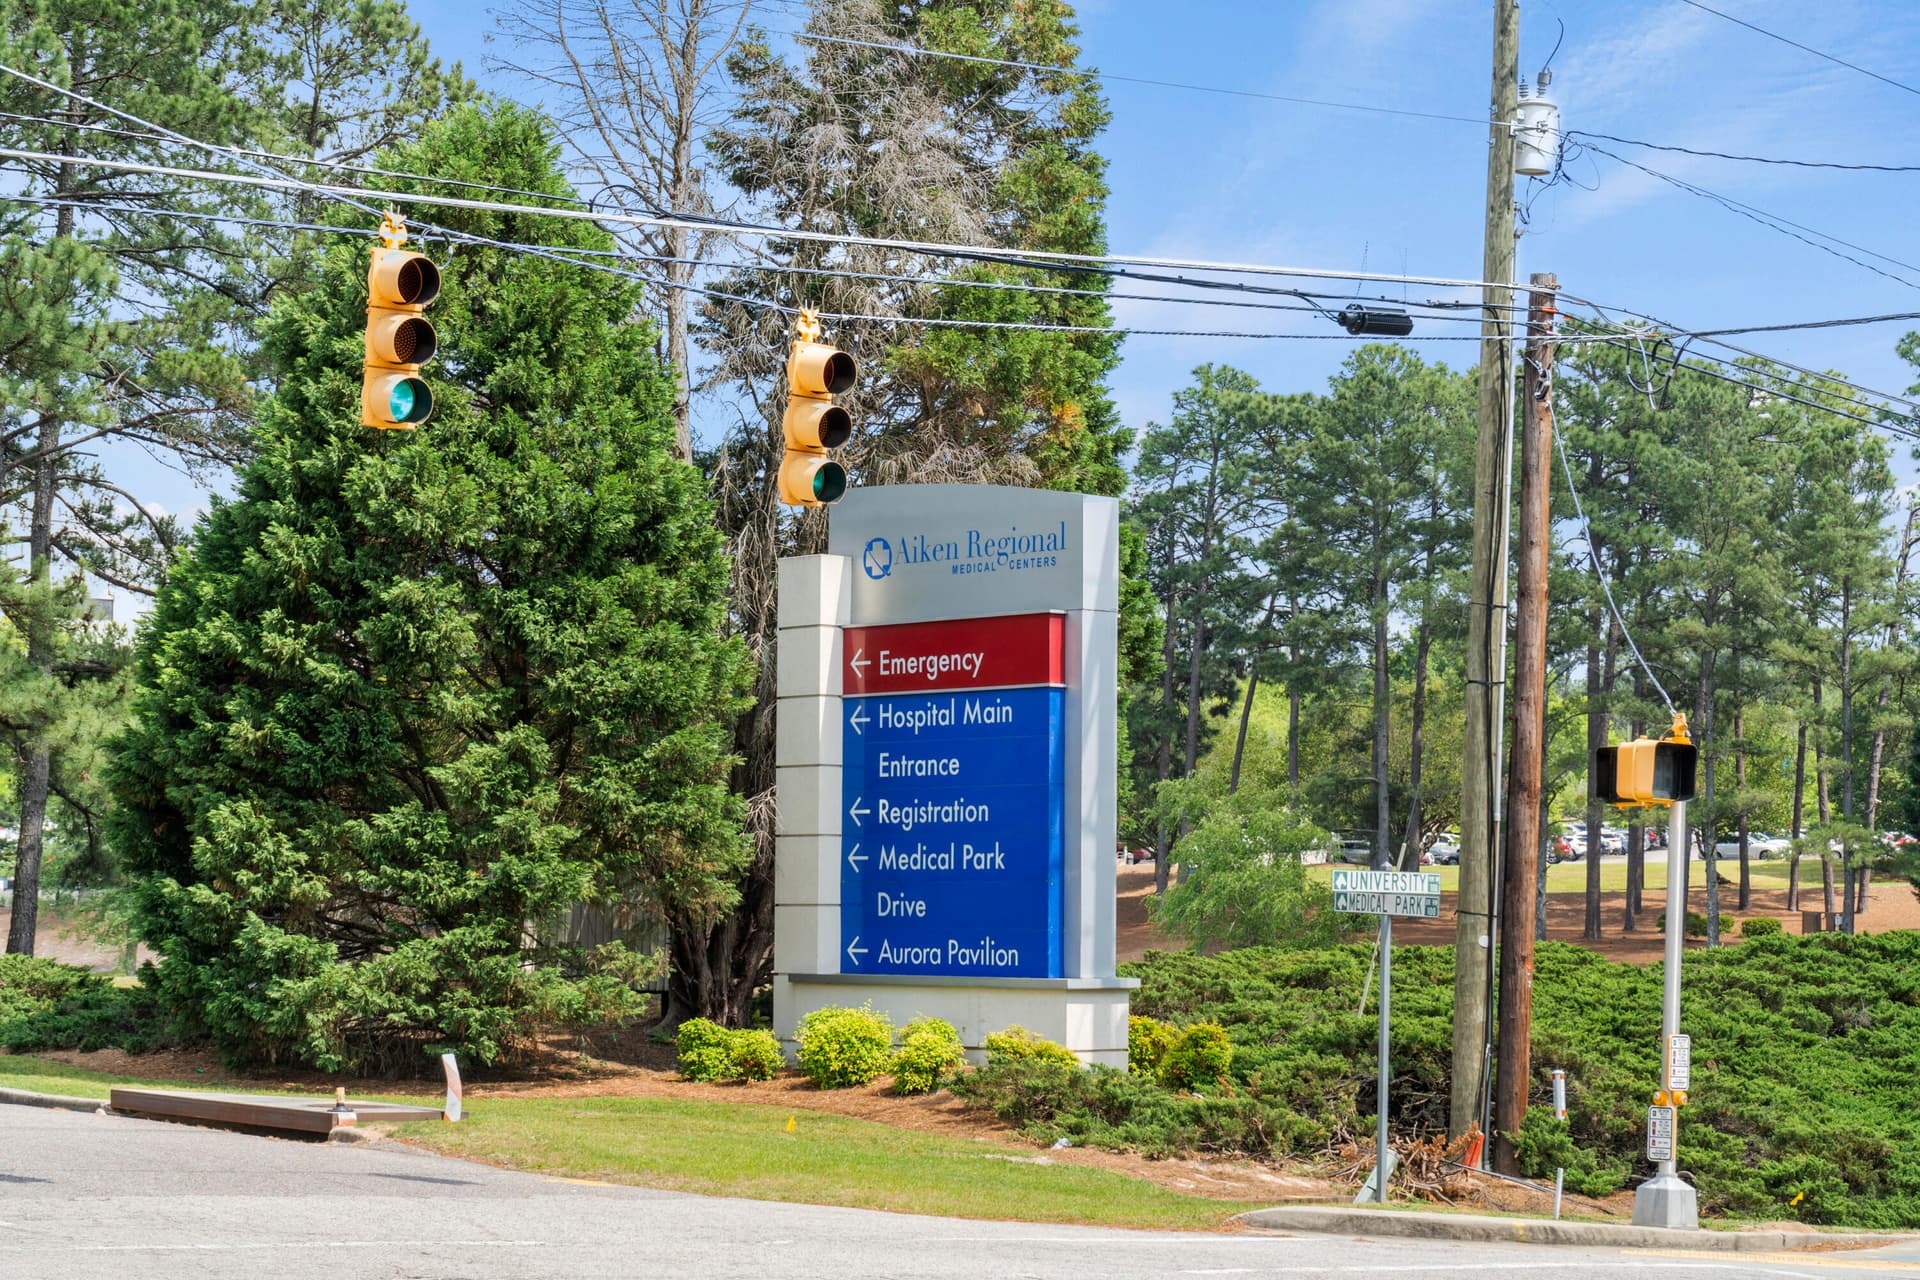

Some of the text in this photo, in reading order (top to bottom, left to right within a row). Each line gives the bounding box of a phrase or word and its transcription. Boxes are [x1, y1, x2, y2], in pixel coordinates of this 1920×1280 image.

[894, 520, 1067, 567] Aiken Regional
[952, 556, 1057, 575] MEDICAL CENTERS
[879, 650, 984, 679] Emergency
[879, 698, 1013, 734] Hospital Main
[879, 752, 960, 778] Entrance
[879, 797, 989, 831] Registration
[878, 841, 1006, 870] Medical Park
[1350, 872, 1426, 891] UNIVERSITY
[877, 892, 927, 917] Drive
[1349, 894, 1388, 913] MEDICAL
[1395, 896, 1423, 915] PARK
[877, 936, 1019, 966] Aurora Pavilion
